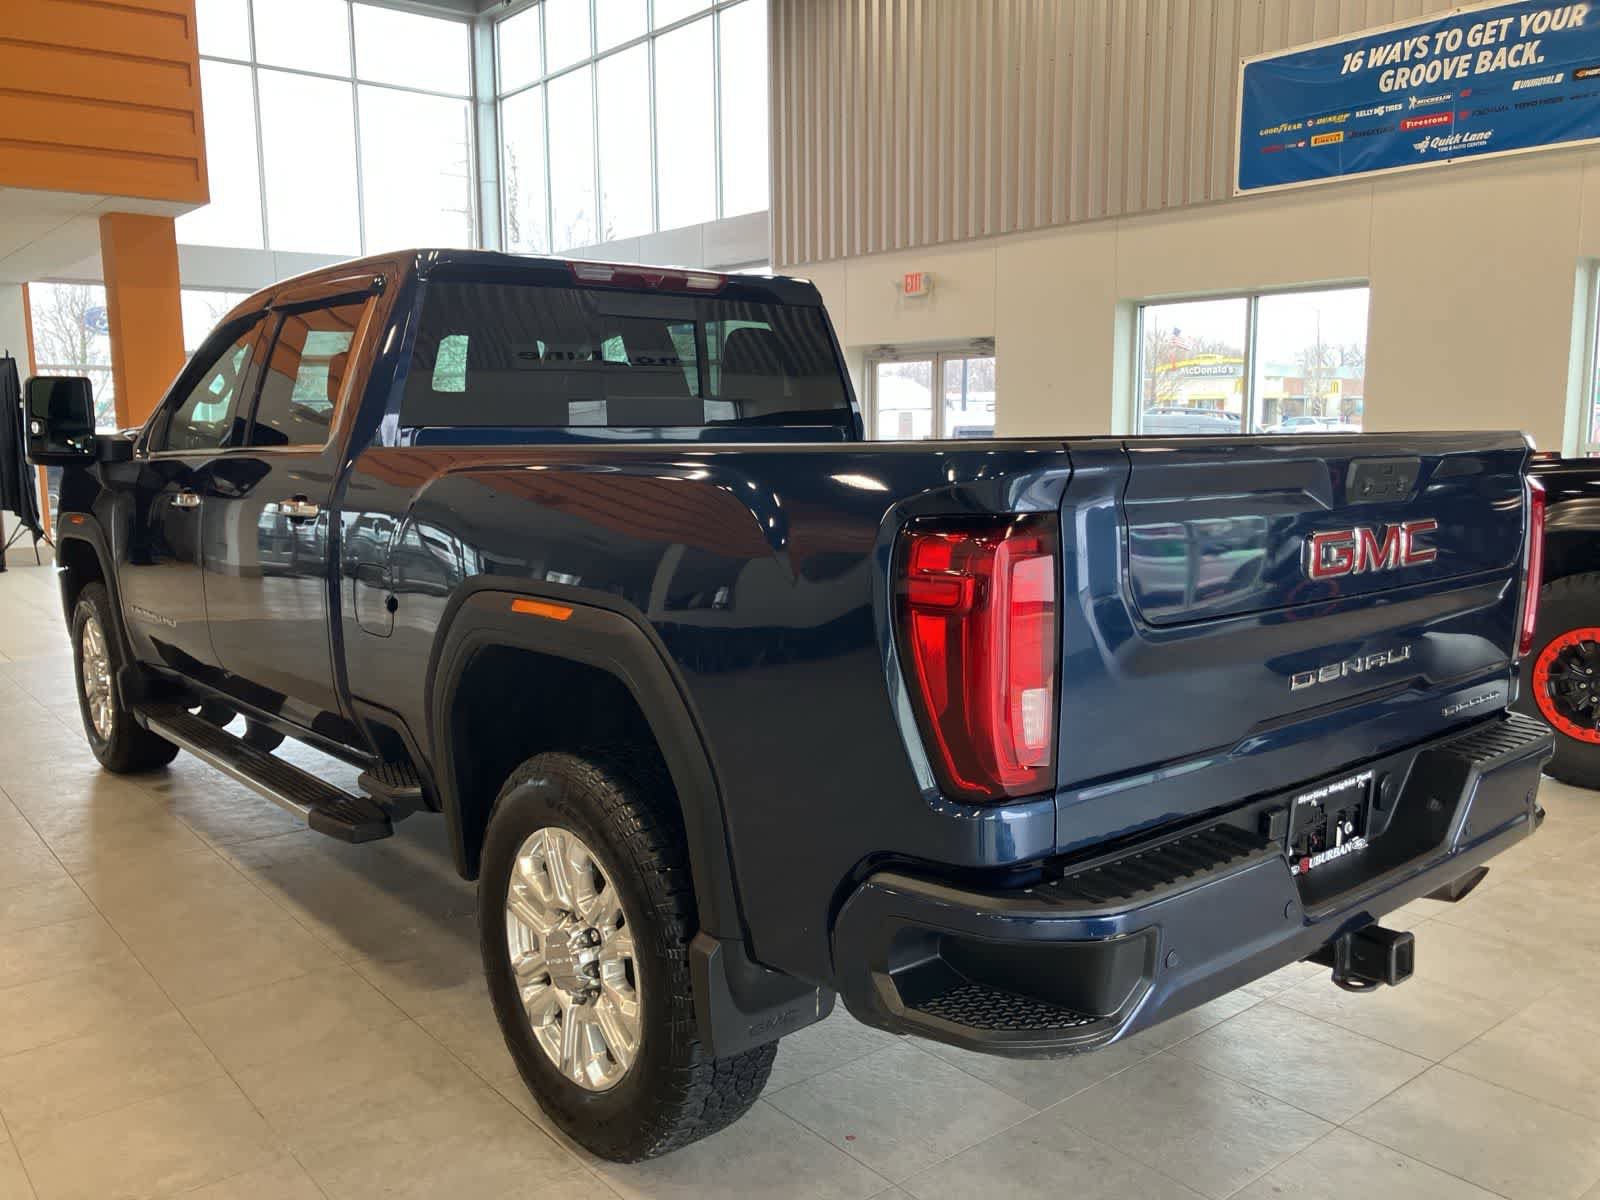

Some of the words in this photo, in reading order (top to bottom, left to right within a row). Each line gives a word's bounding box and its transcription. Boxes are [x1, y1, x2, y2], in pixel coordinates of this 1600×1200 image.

[1340, 50, 1365, 75] 16
[1367, 35, 1430, 68] WAYS
[1434, 28, 1463, 55] TO
[1467, 17, 1515, 48] GET
[1519, 3, 1589, 38] YOUR
[1378, 53, 1473, 93] GROOVE
[1474, 40, 1545, 74] BACK.
[1355, 106, 1375, 118] KELLY
[1385, 103, 1404, 113] TIRES
[1406, 114, 1449, 129] Firestone
[1430, 133, 1462, 149] Quick
[1462, 131, 1492, 143] Lane
[1467, 140, 1487, 148] CENTER
[904, 272, 922, 294] EXIT
[1180, 365, 1234, 377] McDonald's
[1308, 518, 1438, 579] GMC
[1290, 644, 1411, 691] DENALI
[1299, 841, 1352, 873] SUBURBAN
